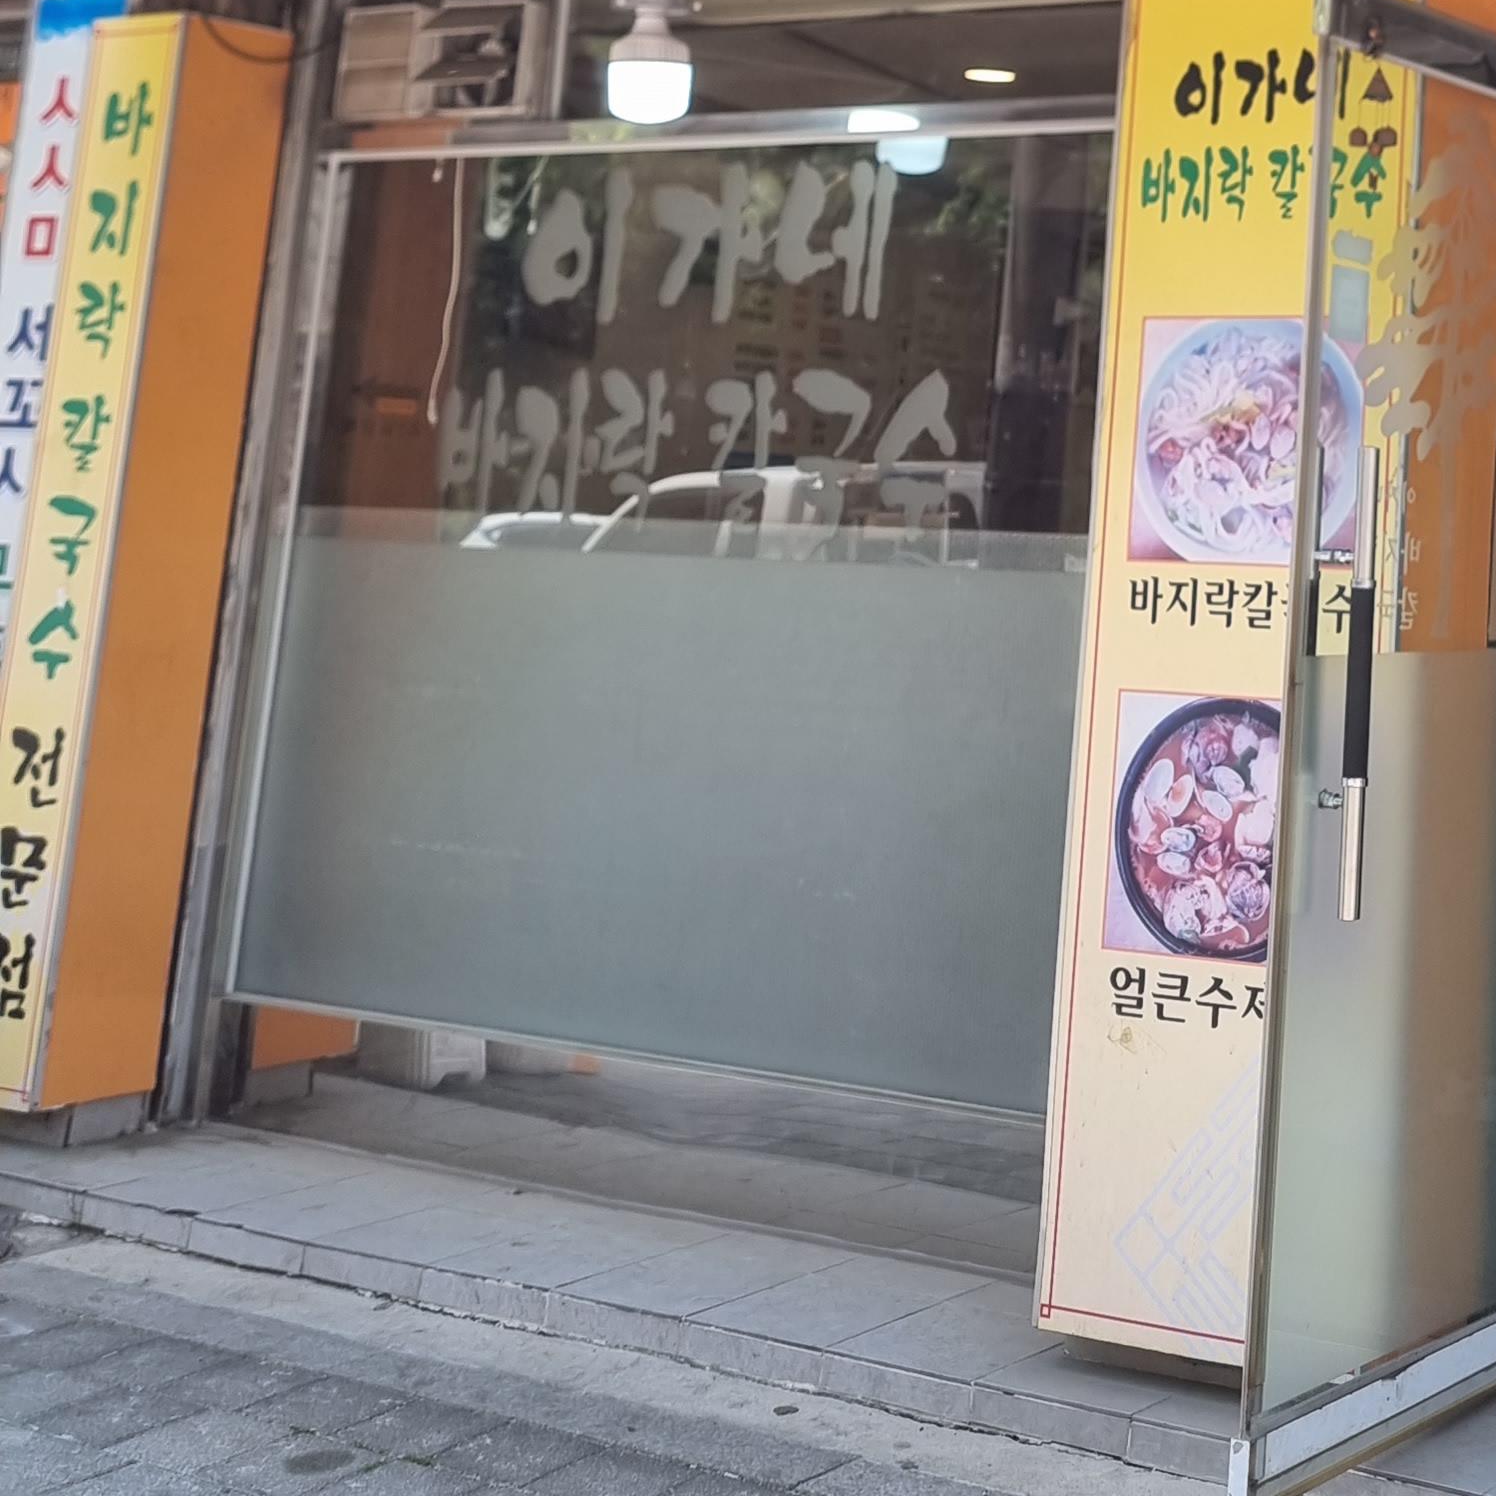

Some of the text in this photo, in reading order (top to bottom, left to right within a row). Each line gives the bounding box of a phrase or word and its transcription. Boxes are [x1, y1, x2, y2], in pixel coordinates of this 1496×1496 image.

[75, 81, 154, 359] 바지락
[521, 160, 899, 323] 이가네
[1141, 145, 1254, 223] 바지락
[28, 395, 112, 680] 칼국수
[1129, 575, 1351, 634] 바지락칼수
